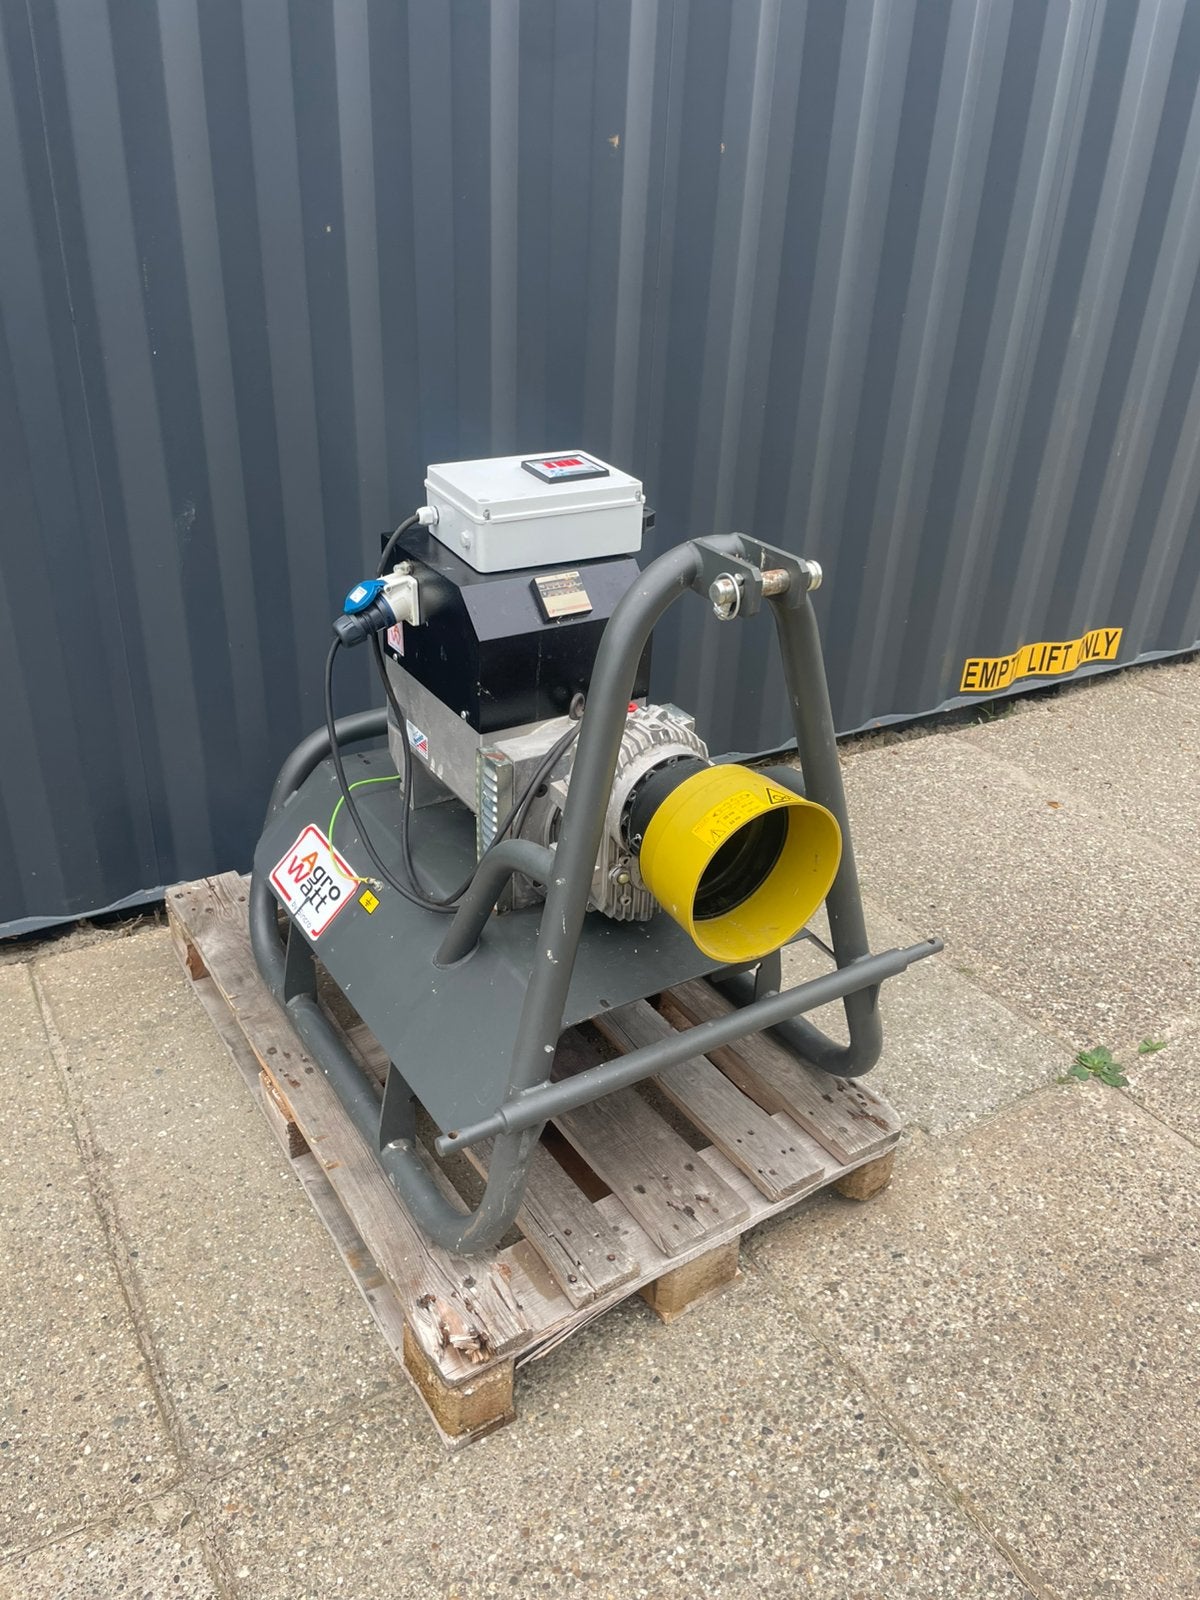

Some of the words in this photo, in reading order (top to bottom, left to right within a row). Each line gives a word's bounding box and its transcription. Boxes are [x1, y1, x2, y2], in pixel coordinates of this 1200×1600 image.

[1027, 644, 1073, 673] LIFT
[288, 855, 328, 914] Watt
[302, 851, 341, 901] Agro
